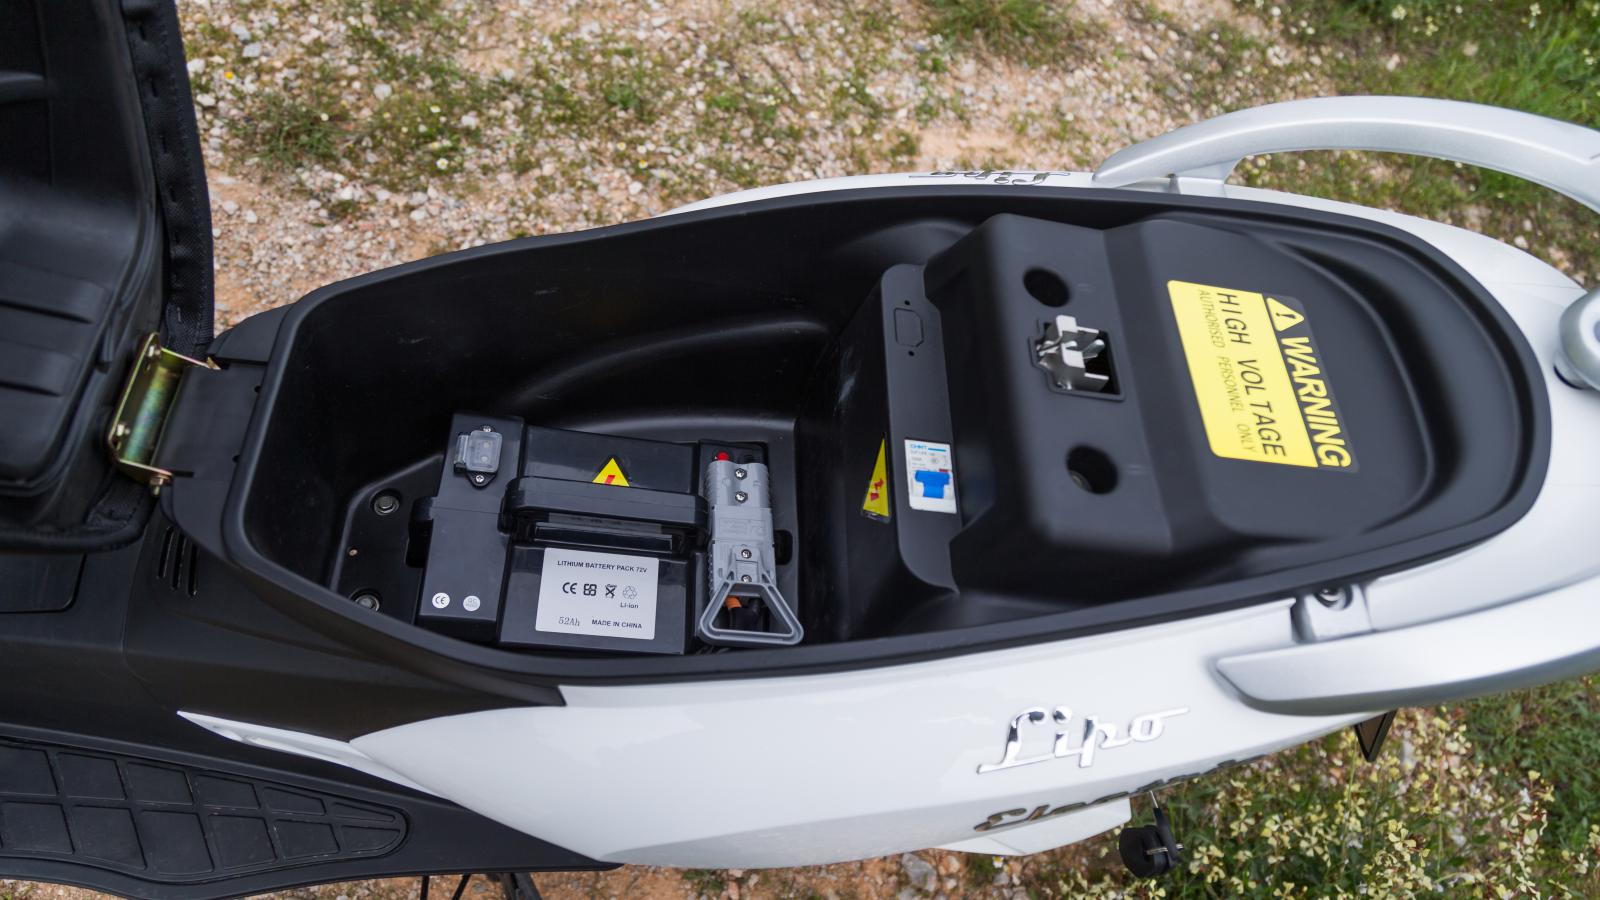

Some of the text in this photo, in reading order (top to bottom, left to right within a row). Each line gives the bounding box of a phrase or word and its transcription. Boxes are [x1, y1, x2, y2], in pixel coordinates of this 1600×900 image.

[1199, 289, 1255, 452] AUTHORISED PERSONNEL ONLY
[1217, 292, 1287, 457] HIGH VOLTAGE
[1281, 337, 1351, 467] WARNING
[557, 560, 584, 568] LITHIUM
[585, 562, 615, 571] BATTERY
[616, 564, 635, 572] PACK
[558, 616, 580, 627] 52Ah
[591, 619, 612, 627] MADE
[621, 621, 643, 629] CHINA
[976, 706, 1190, 774] Lipo
